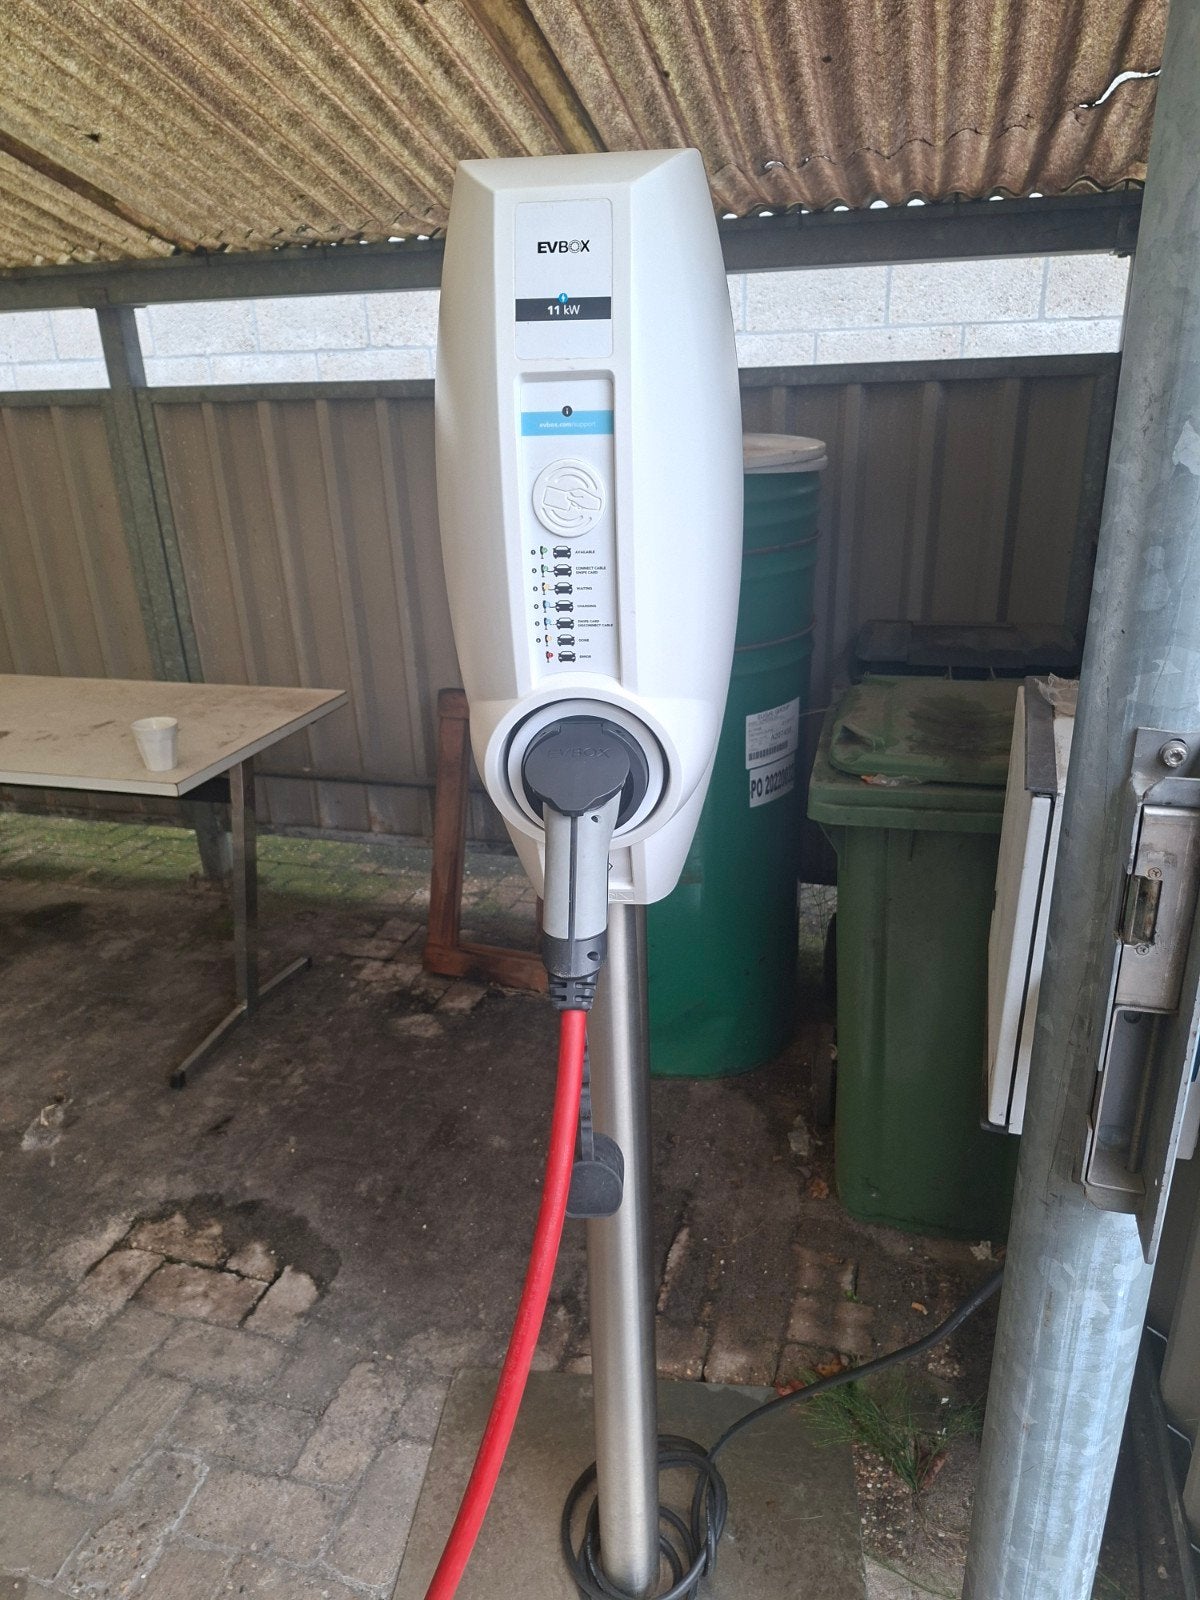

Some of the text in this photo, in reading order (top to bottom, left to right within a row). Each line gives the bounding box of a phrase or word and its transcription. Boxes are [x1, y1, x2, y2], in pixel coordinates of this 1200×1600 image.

[537, 239, 590, 254] EVBOX
[547, 304, 581, 315] 11 kW
[548, 746, 610, 759] EVBOX
[750, 778, 763, 799] PO
